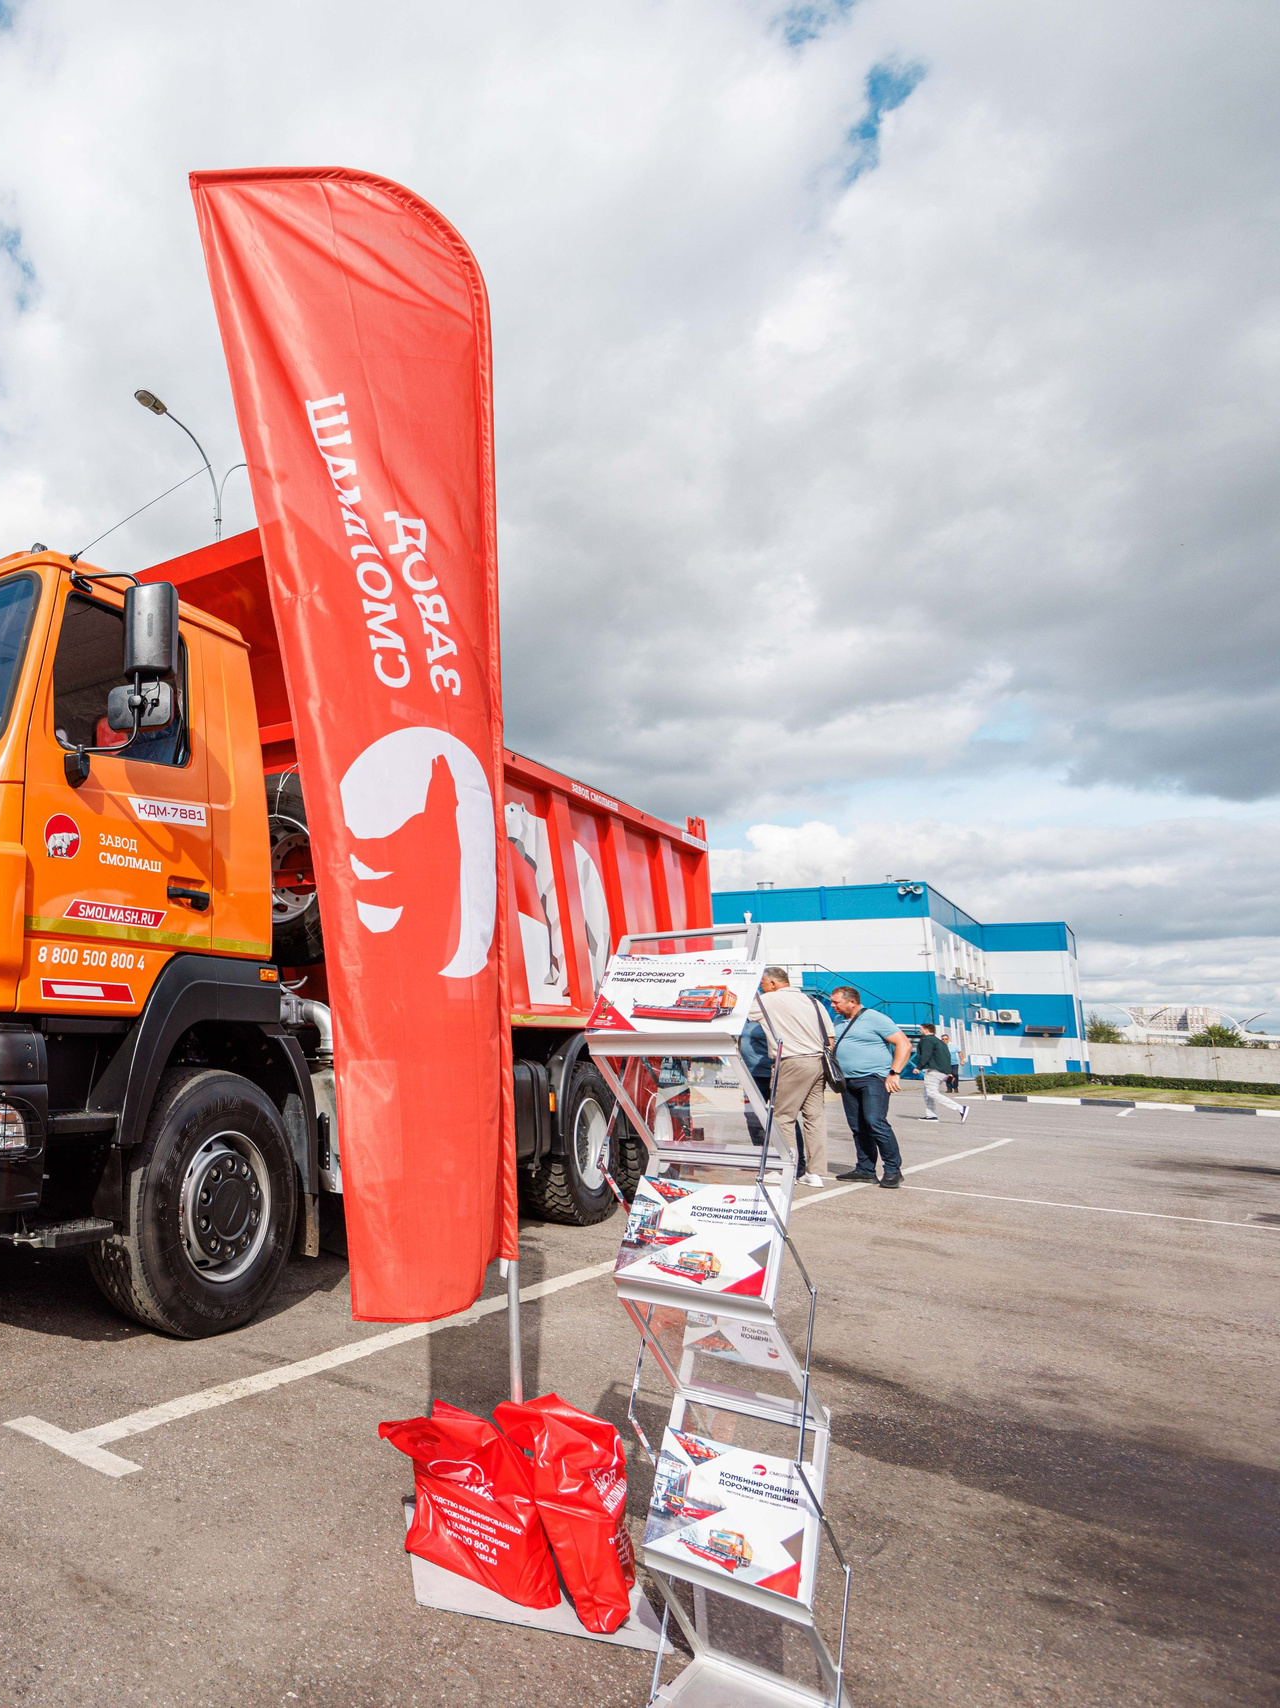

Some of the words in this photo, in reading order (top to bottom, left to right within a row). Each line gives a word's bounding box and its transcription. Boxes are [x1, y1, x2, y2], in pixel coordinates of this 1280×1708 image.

[137, 802, 205, 821] КДМ-7881
[99, 833, 138, 853] ЗАВОД
[98, 852, 162, 873] СМОЛМАШ
[78, 904, 155, 926] SMOLMASH.RU
[37, 946, 47, 963] 8
[51, 948, 79, 965] 800
[82, 950, 107, 967] 500
[111, 953, 134, 970] 800
[137, 955, 145, 971] 4
[690, 1211, 733, 1220] ДОРОЖНАЯ
[733, 1215, 767, 1223] МАШИНА
[691, 1205, 768, 1216] КОМБИНИРОВАННАЯ
[718, 1478, 764, 1496] ДОРОЖНАЯ
[764, 1491, 799, 1505] МАШИНА
[720, 1471, 799, 1496] КОМБИНИРОВАННАЯ
[458, 1502, 523, 1535] КОМБИНИРОВАННЫХ
[471, 1519, 496, 1535] МАШИН
[474, 1540, 489, 1553] 800
[491, 1548, 497, 1556] 4
[480, 1532, 510, 1550] ТЕХНИКИ
